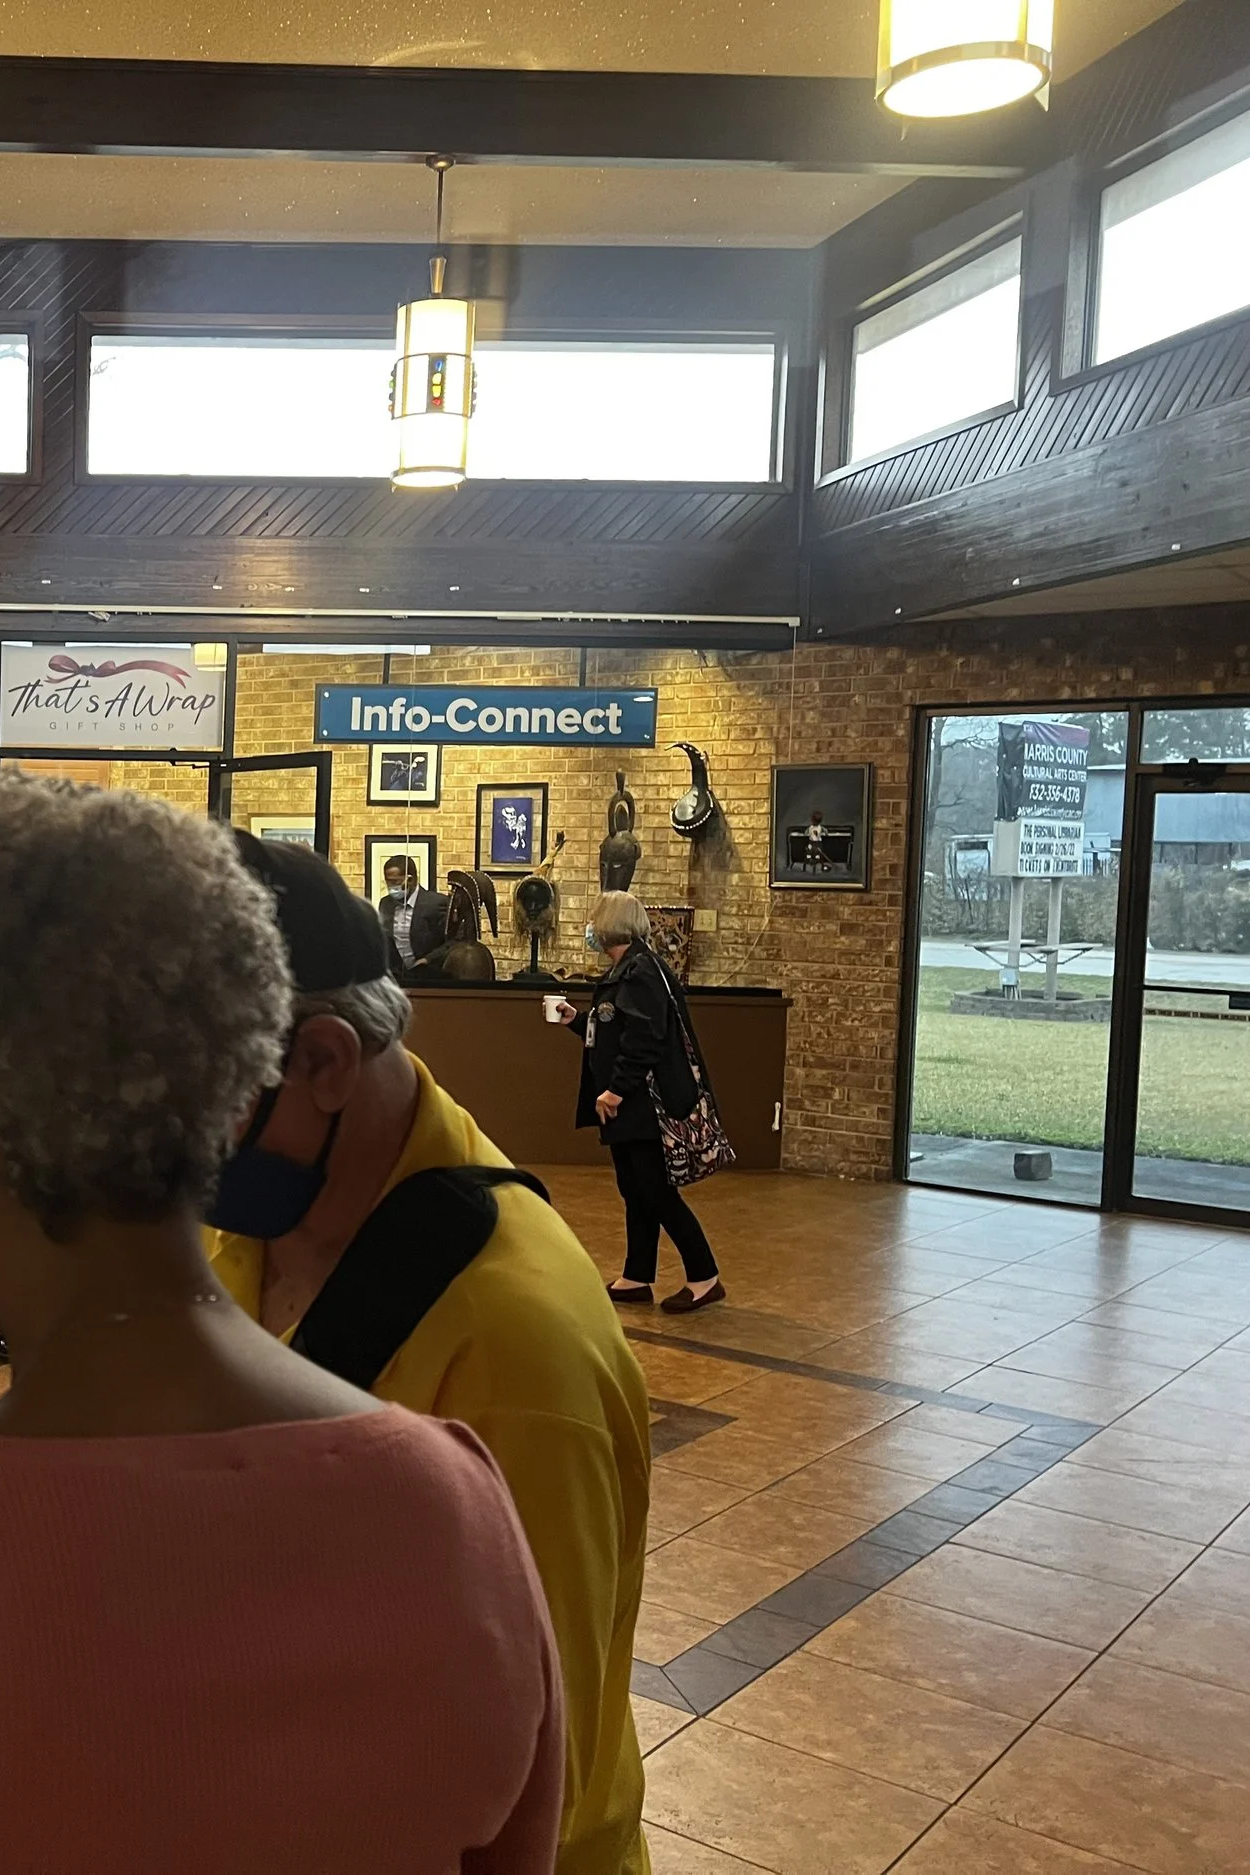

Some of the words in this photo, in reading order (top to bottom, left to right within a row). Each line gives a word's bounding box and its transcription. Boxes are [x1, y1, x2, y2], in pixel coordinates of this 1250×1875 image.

[8, 678, 99, 717] That's
[104, 682, 134, 718] A
[132, 682, 216, 724] Wrap
[350, 696, 623, 735] Info-Connect
[49, 721, 99, 731] GIFT
[119, 722, 175, 732] SHOP
[1056, 746, 1088, 766] COUNTY
[1054, 767, 1068, 781] ARTS
[1068, 770, 1087, 783] CENTER
